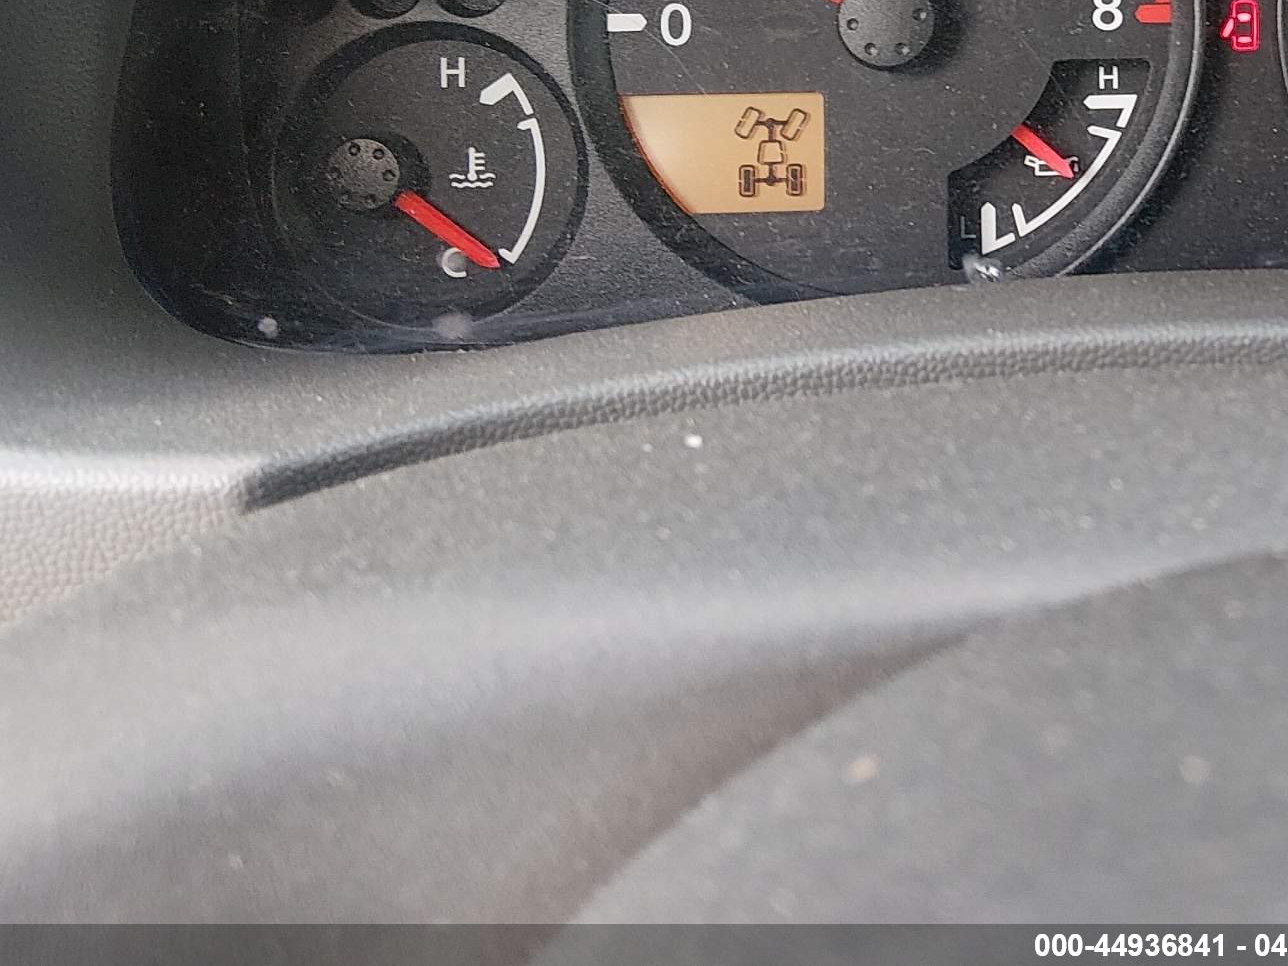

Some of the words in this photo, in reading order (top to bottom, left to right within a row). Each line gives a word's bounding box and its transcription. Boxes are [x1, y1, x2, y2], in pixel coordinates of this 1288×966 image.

[660, 2, 693, 47] 0
[439, 56, 466, 89] H
[1098, 65, 1119, 90] H
